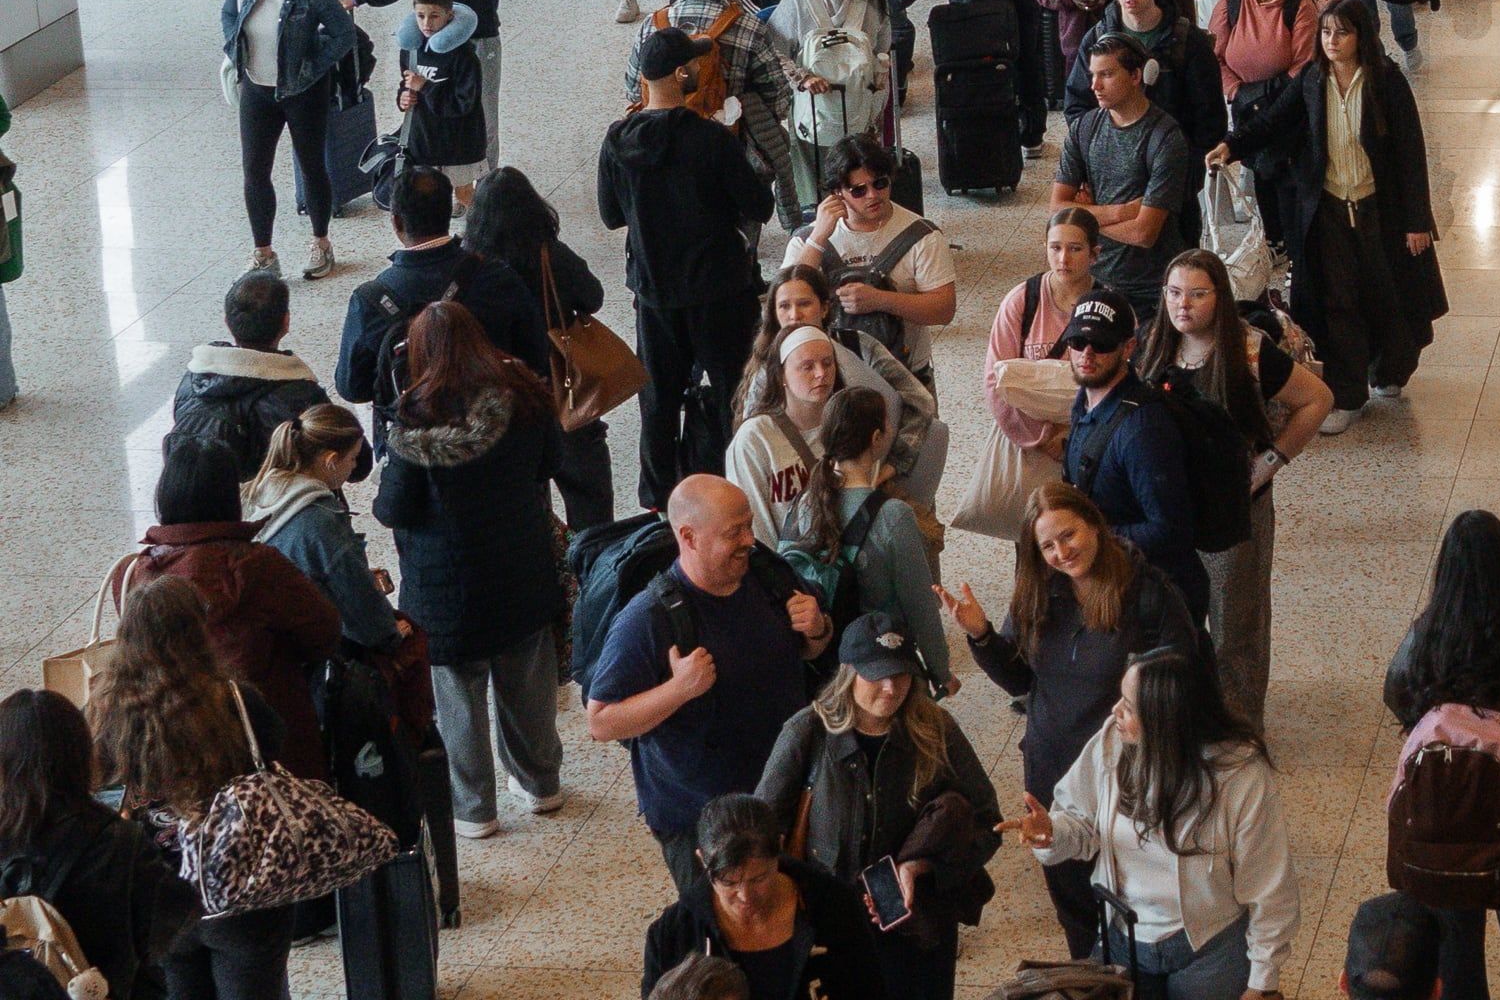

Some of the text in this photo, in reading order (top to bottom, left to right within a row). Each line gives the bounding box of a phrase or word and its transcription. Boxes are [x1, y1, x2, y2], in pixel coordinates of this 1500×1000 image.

[1074, 301, 1116, 322] NEW YORK
[771, 463, 809, 502] NEW
